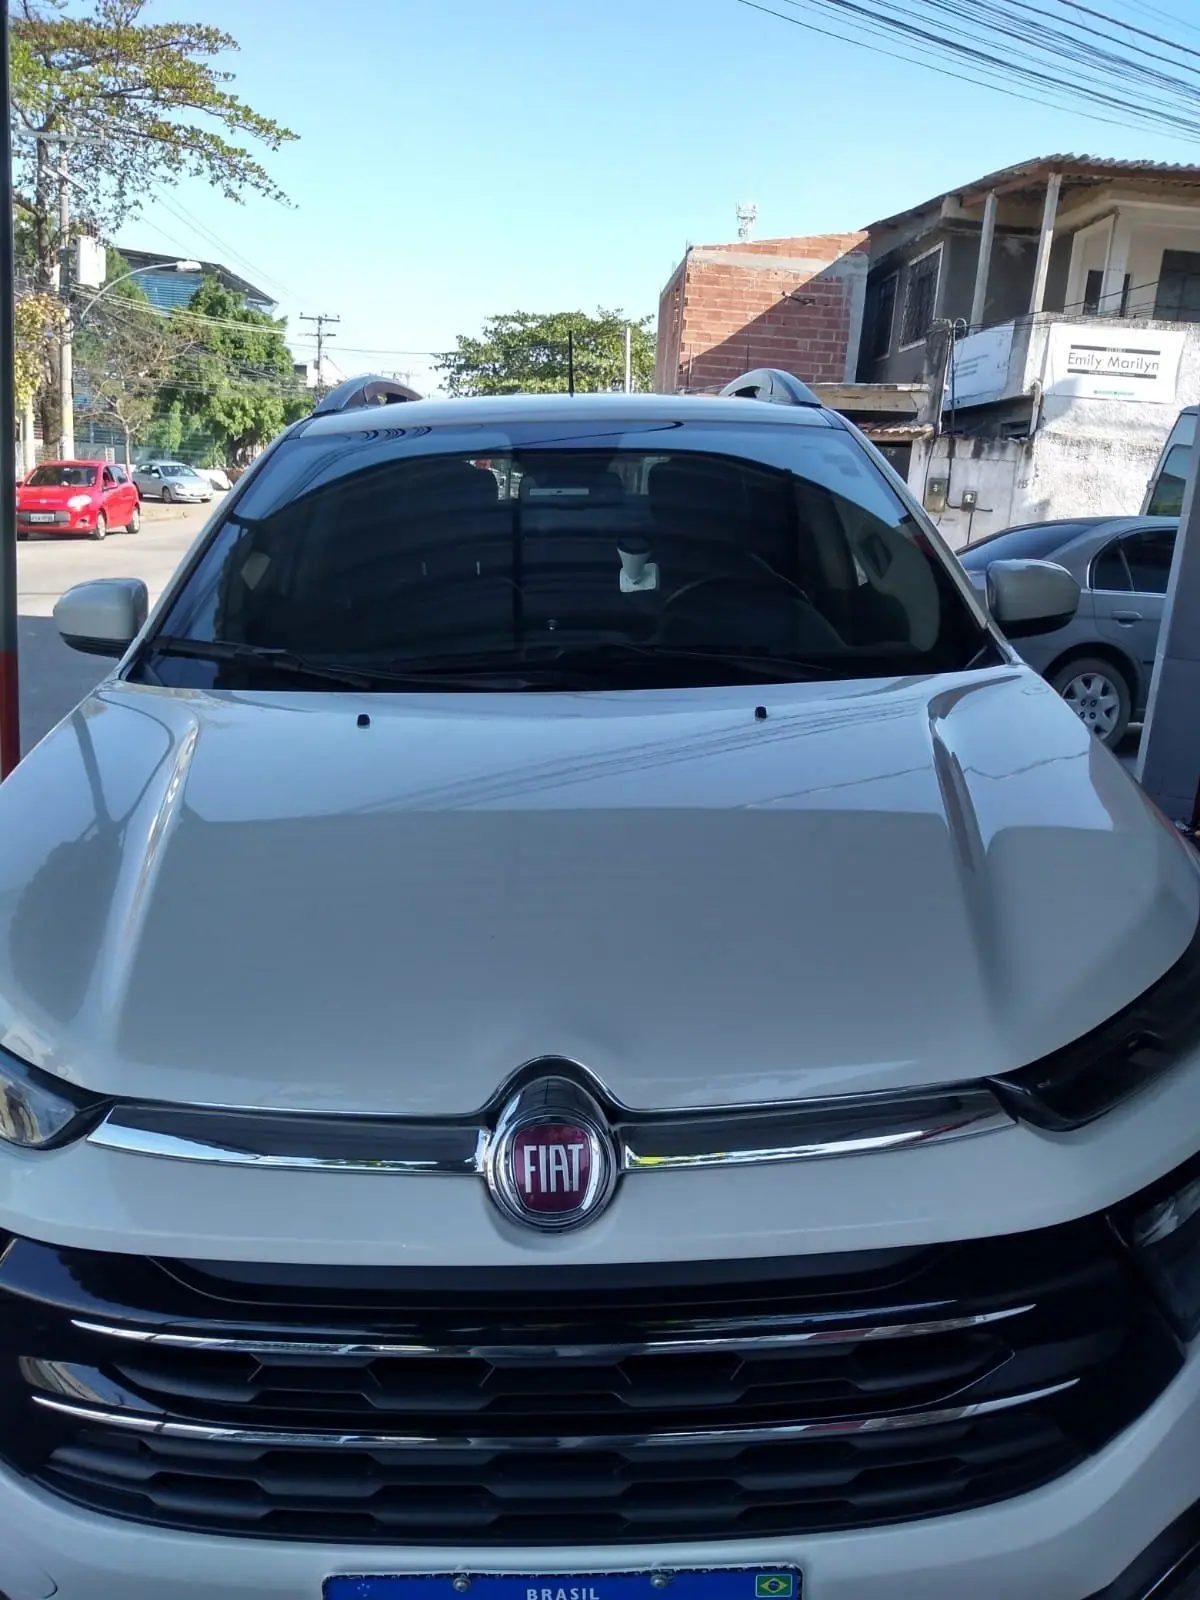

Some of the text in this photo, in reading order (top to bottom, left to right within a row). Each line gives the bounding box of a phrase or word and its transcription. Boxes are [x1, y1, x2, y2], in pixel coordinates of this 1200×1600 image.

[1068, 352, 1159, 373] Emily Marilyn
[523, 1143, 584, 1193] FIAT
[526, 1588, 600, 1600] BRASIL
